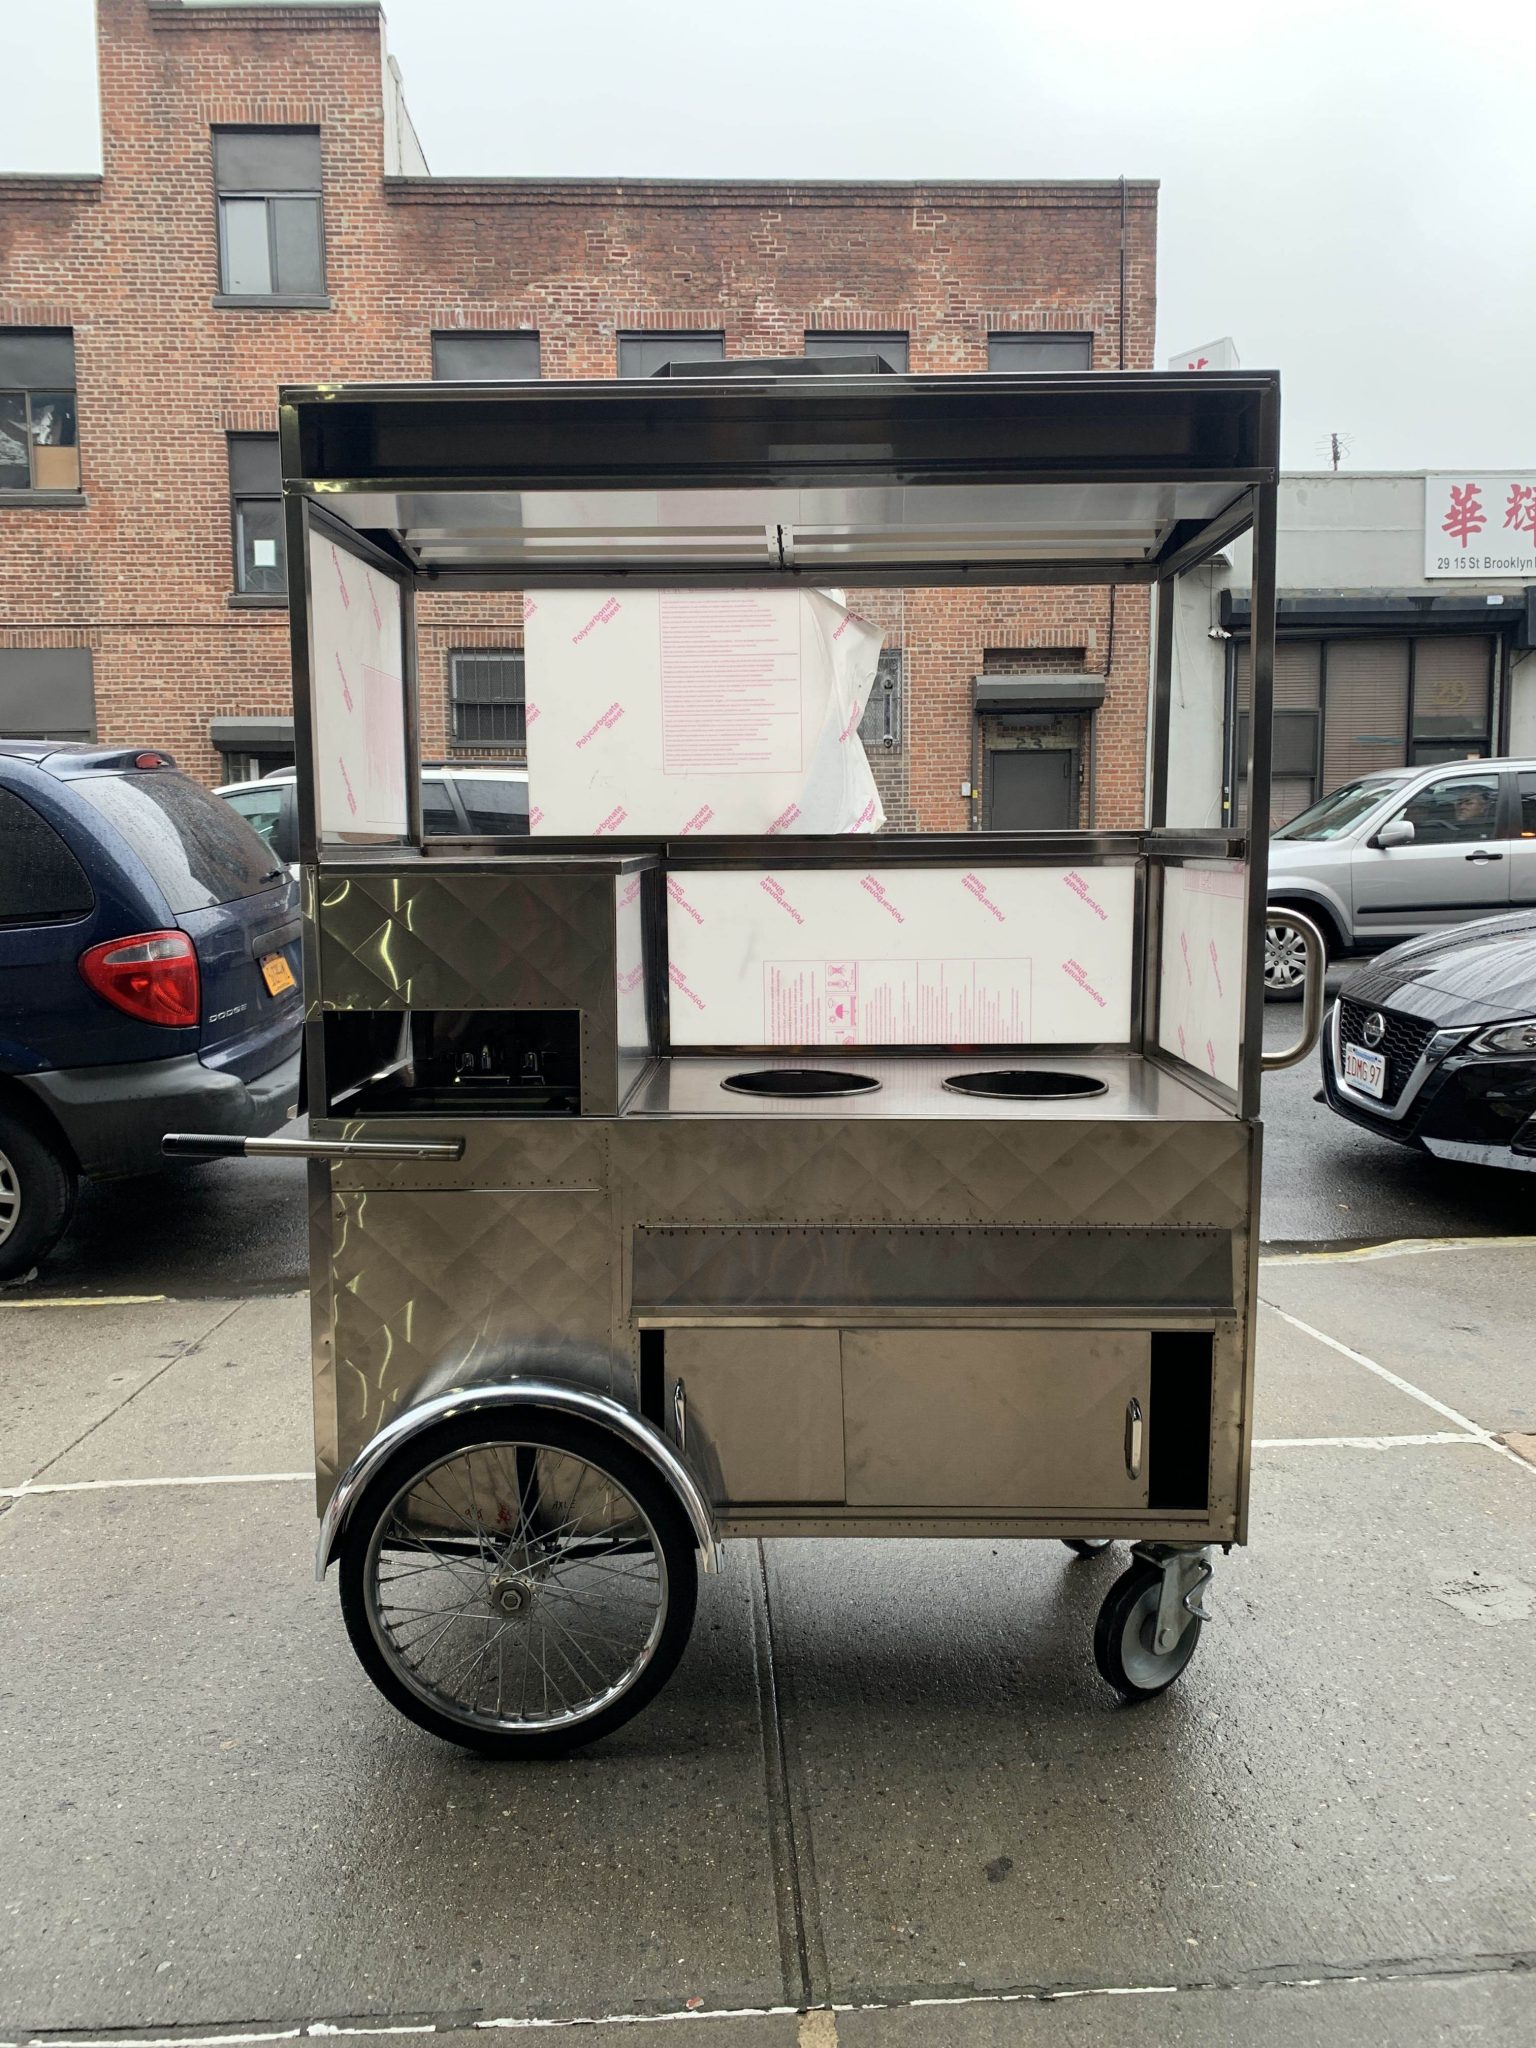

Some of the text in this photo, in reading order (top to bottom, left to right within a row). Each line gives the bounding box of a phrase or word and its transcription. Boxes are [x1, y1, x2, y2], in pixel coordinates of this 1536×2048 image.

[1437, 557, 1450, 569] 29
[1454, 557, 1466, 569] 15
[1468, 556, 1480, 569] St
[1484, 556, 1533, 571] Brooklyn
[572, 596, 617, 645] Polycarbonate
[601, 602, 622, 625] Sheet
[576, 701, 620, 749] Polycarbonate
[604, 708, 625, 729] Sheet
[607, 811, 628, 832] Sheet
[694, 810, 715, 831] Sheet
[782, 808, 802, 830] Sheet
[765, 875, 785, 896] Sheet
[865, 874, 886, 895] Sheet
[966, 872, 987, 894] Sheet
[1068, 871, 1089, 892] Sheet
[760, 879, 805, 925] Polycarbonate
[860, 879, 905, 924] Polycarbonate
[961, 877, 1006, 922] Polycarbonate
[1063, 875, 1109, 921] Polycarbonate
[1067, 958, 1088, 979] Sheet
[1061, 962, 1107, 1008] Polycarbonate
[208, 1003, 248, 1023] DODGE
[1369, 1063, 1382, 1087] 97
